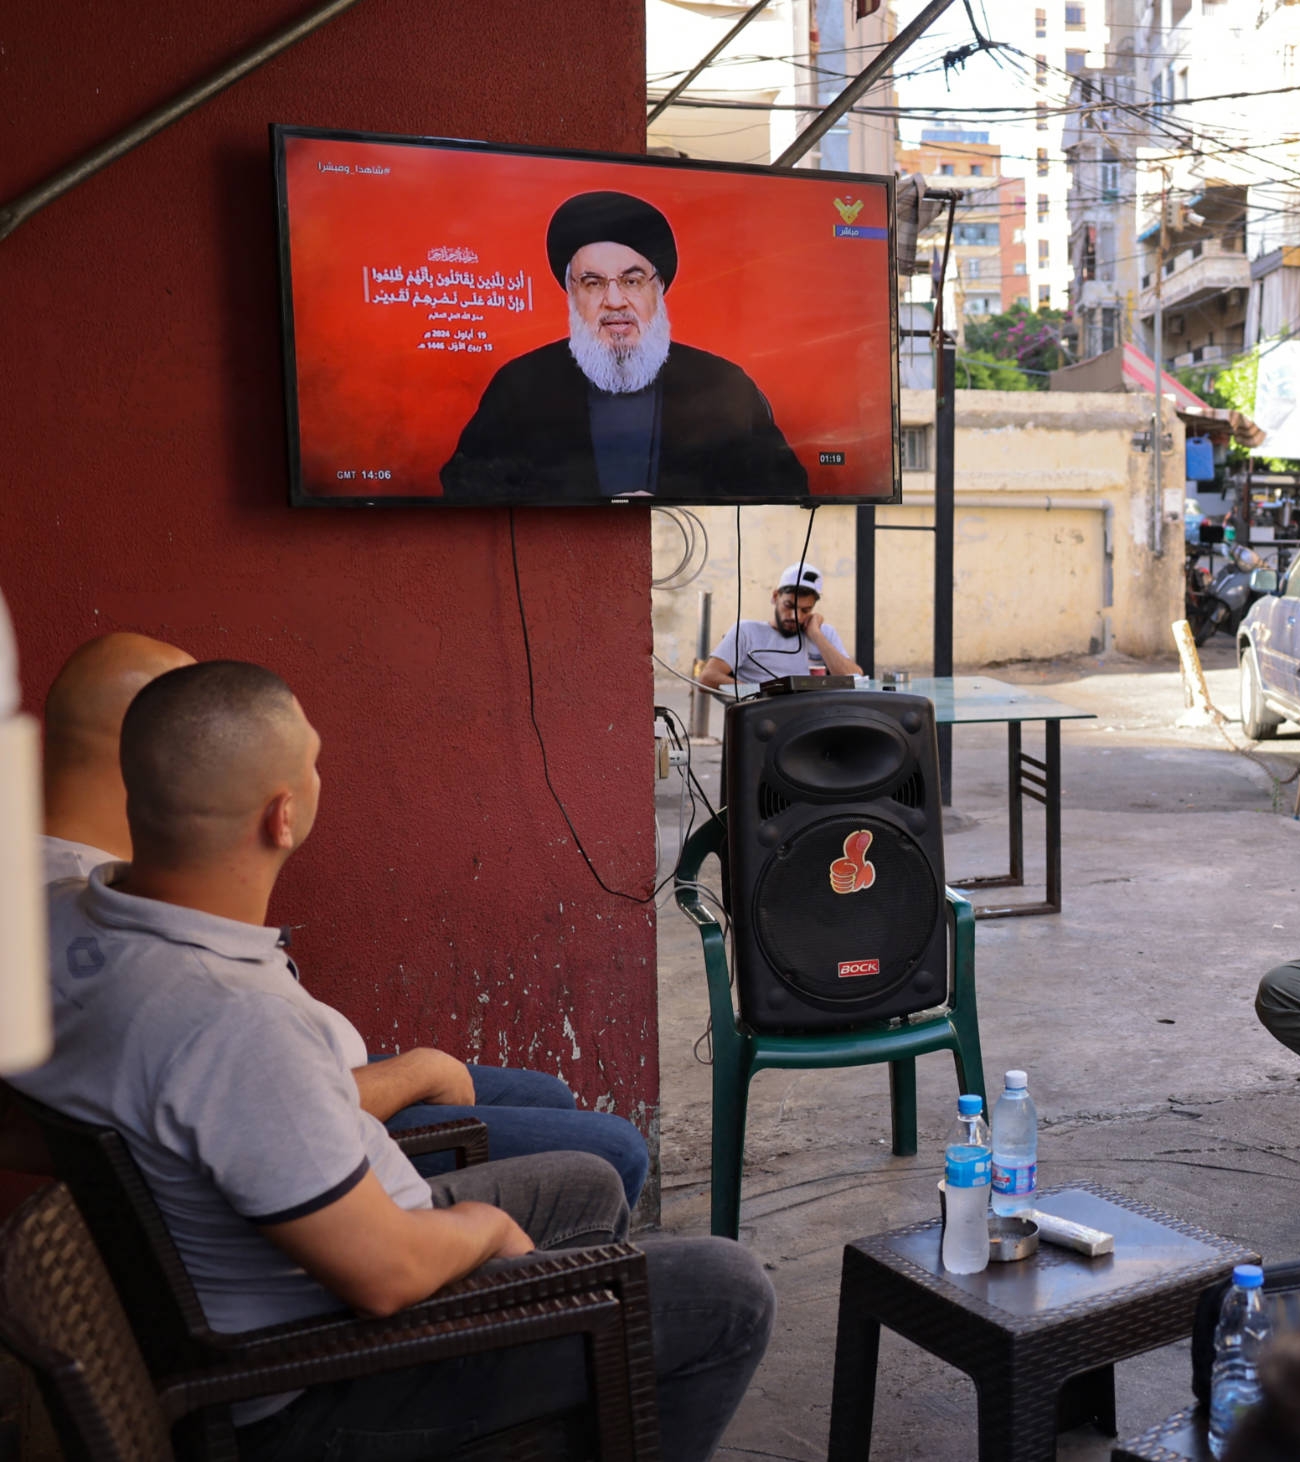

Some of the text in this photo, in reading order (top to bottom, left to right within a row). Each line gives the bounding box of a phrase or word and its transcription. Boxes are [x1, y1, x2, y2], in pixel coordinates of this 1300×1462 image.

[839, 227, 859, 238] مباشر
[431, 329, 450, 338] 2024
[477, 331, 487, 339] 19
[336, 469, 391, 480] GMT 14:06
[840, 963, 878, 975] BOCK
